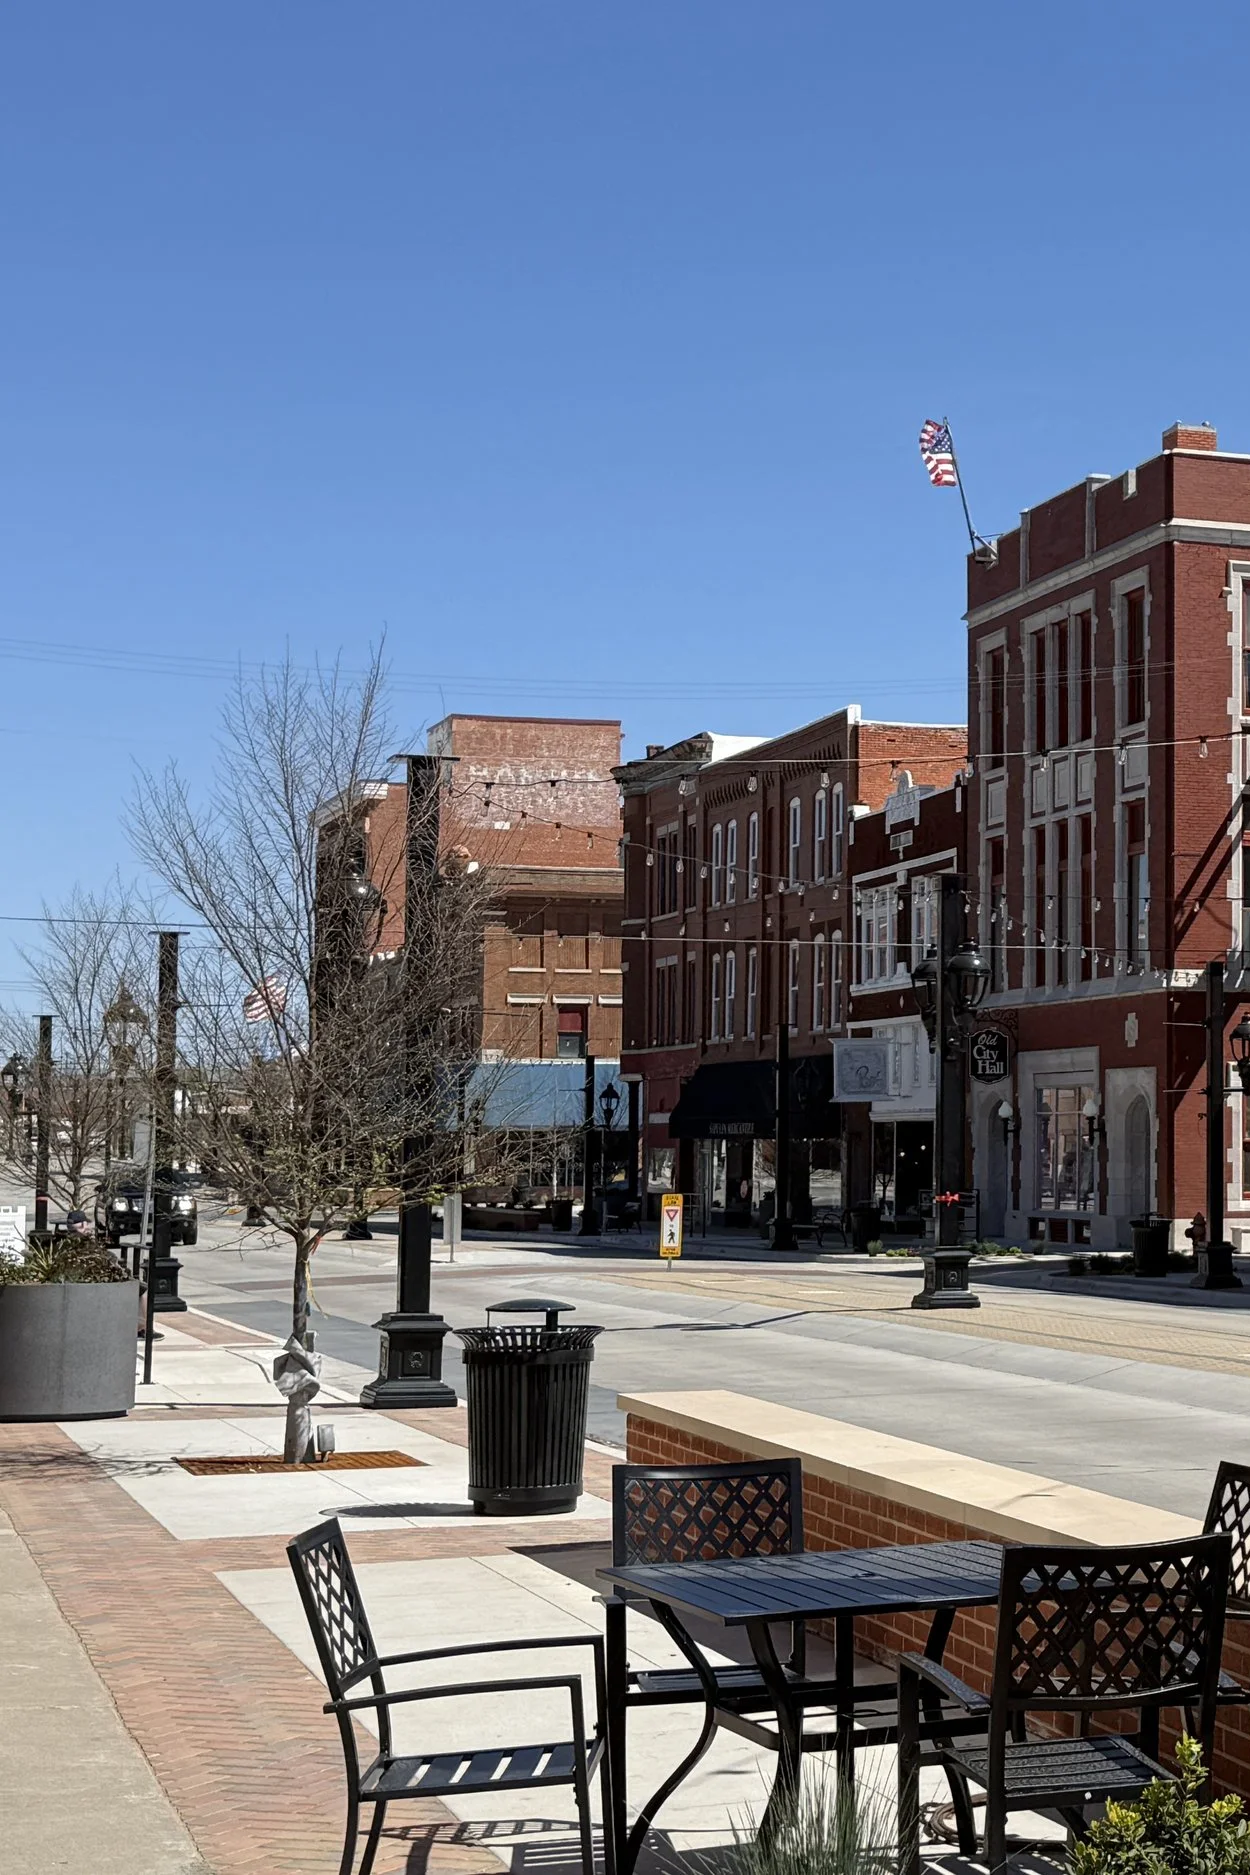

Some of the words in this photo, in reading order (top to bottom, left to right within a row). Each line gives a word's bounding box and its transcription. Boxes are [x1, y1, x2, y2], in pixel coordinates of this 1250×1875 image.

[977, 1033, 998, 1046] Old
[972, 1044, 999, 1062] City
[977, 1059, 1004, 1074] Hall
